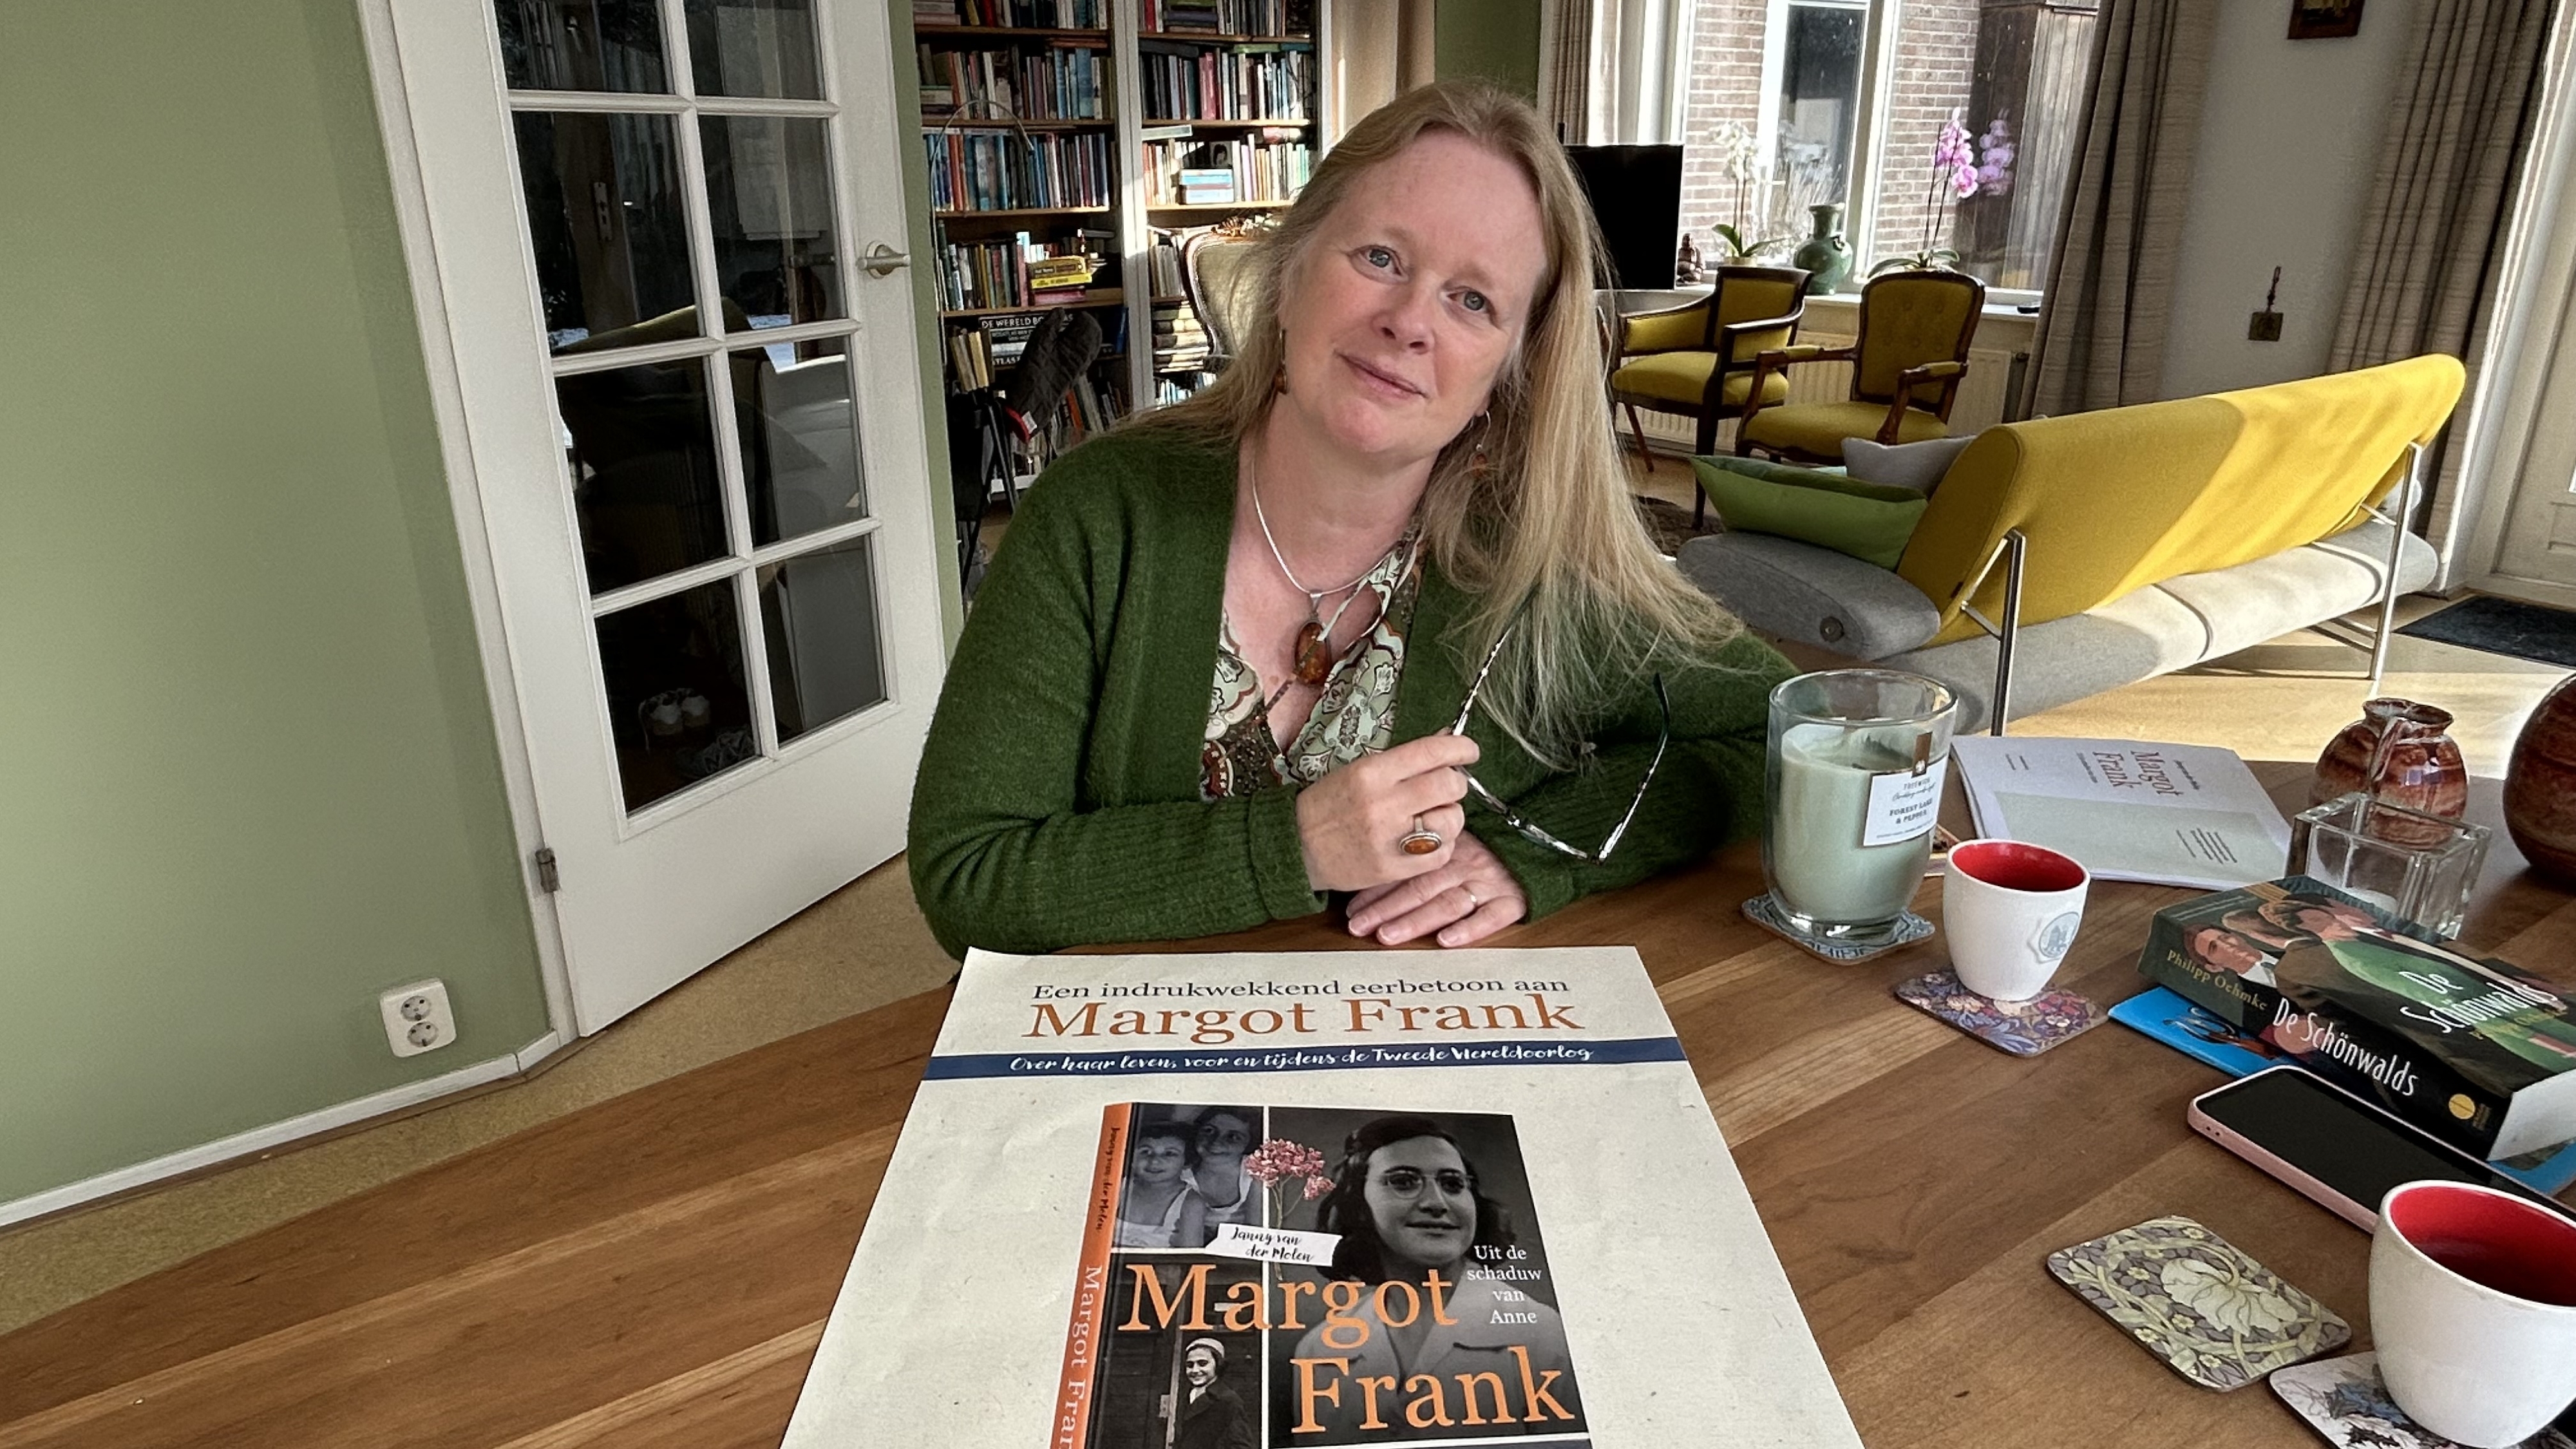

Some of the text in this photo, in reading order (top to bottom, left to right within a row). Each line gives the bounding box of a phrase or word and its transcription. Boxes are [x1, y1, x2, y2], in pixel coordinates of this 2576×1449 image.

[981, 321, 994, 329] DE
[995, 317, 1031, 328] WERELD
[2092, 752, 2142, 788] Frank
[2130, 751, 2184, 795] Margot
[2167, 949, 2211, 983] Philipp
[1031, 979, 1569, 999] Een indrukwekkend eerbetoon aan
[2399, 971, 2464, 994] De
[1021, 993, 1586, 1045] Margot Frank
[2400, 980, 2559, 1034] Schönwalds
[1010, 1045, 1594, 1071] Over haar leven, voor en tijdens de Tweede Wereldoorlog
[2273, 997, 2298, 1034] De
[2300, 1011, 2420, 1096] Schönwalds
[1095, 1198, 1109, 1231] Molen
[1231, 1227, 1302, 1245] Janny van
[1245, 1244, 1315, 1262] der Molen
[1473, 1244, 1528, 1260] Uit de
[1466, 1264, 1542, 1280] schaduw
[1118, 1263, 1459, 1349] Margot
[1492, 1291, 1526, 1302] van
[1490, 1309, 1538, 1324] Anne
[1059, 1265, 1103, 1449] Margot Fran
[1290, 1345, 1575, 1434] Frank
